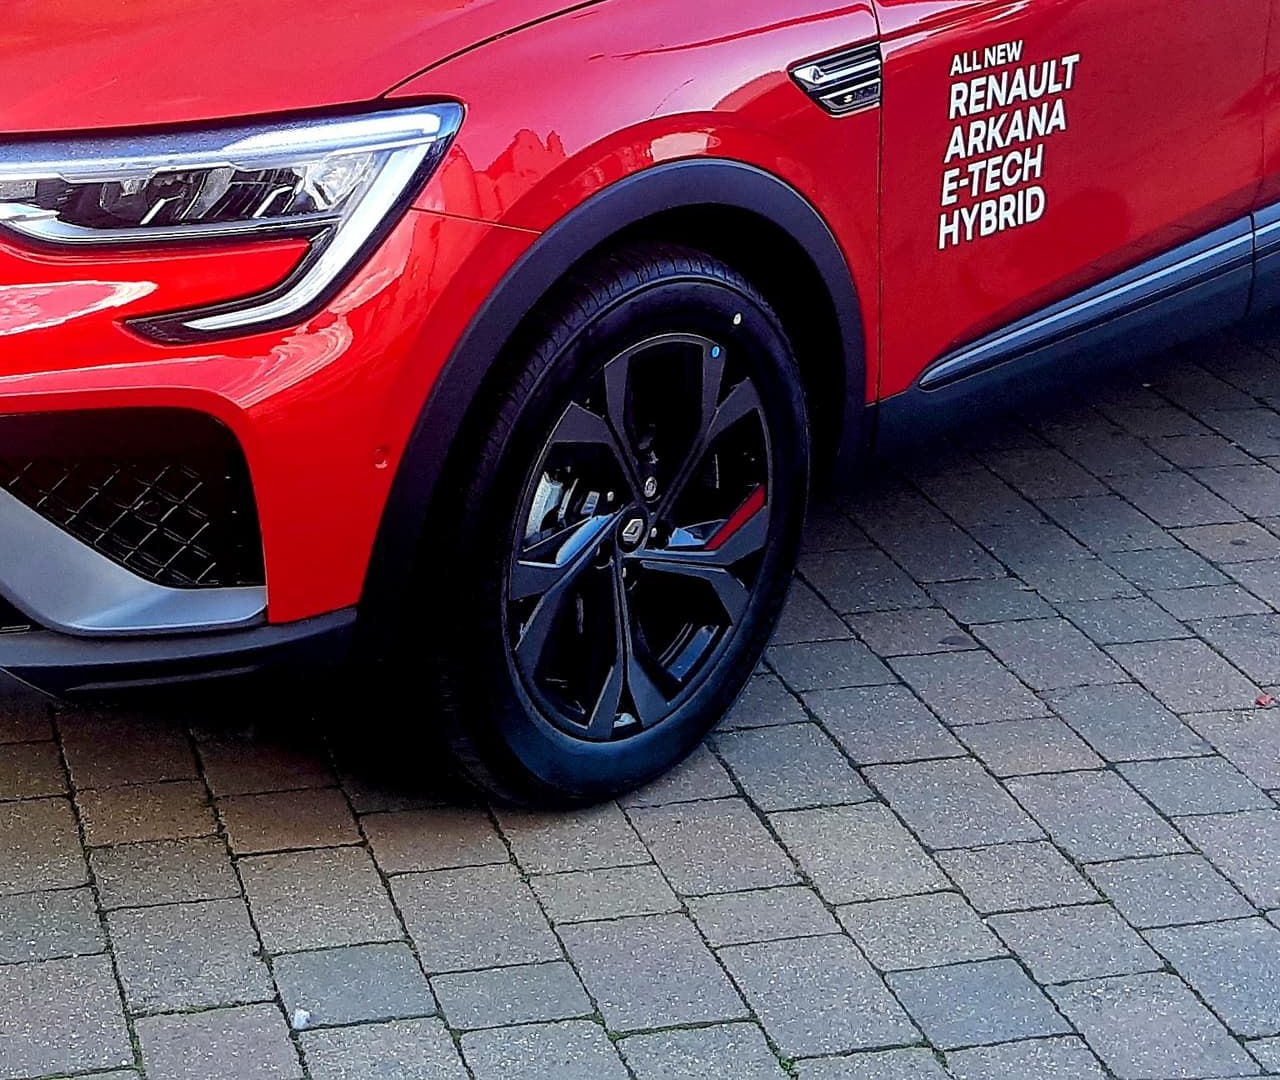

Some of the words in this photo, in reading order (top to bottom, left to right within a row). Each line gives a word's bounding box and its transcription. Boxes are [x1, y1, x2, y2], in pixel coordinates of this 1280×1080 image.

[949, 50, 982, 77] ALL
[984, 39, 1023, 68] NEW
[949, 53, 1080, 120] RENAULT
[943, 98, 1067, 164] ARKANA
[941, 143, 1044, 207] E-TECH
[938, 185, 1046, 250] HYBRID
